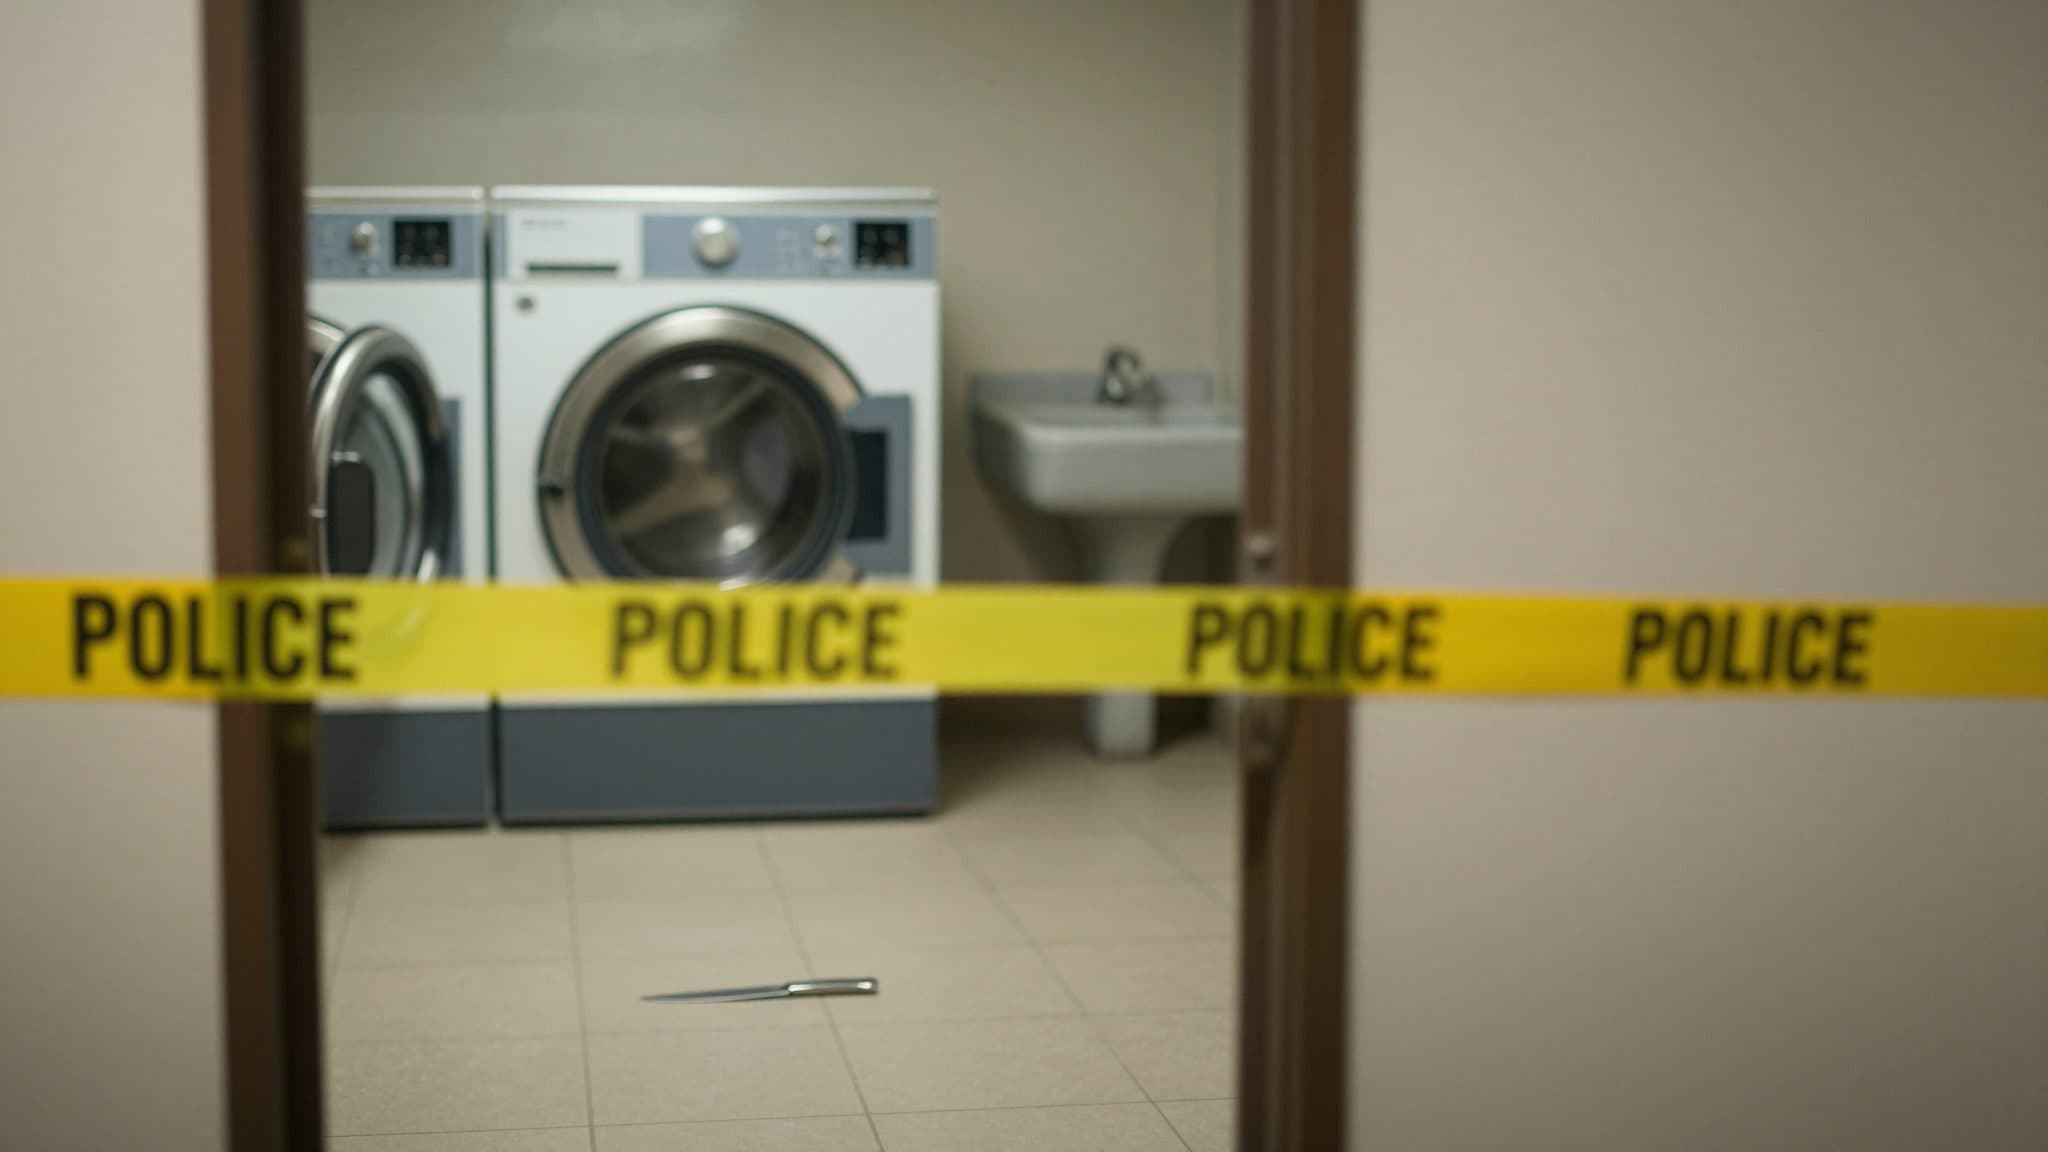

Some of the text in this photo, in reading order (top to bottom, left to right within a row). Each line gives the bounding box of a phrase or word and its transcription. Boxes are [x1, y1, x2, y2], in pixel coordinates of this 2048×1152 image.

[70, 593, 1875, 686] POLICE POLICE POLICE POLICE
